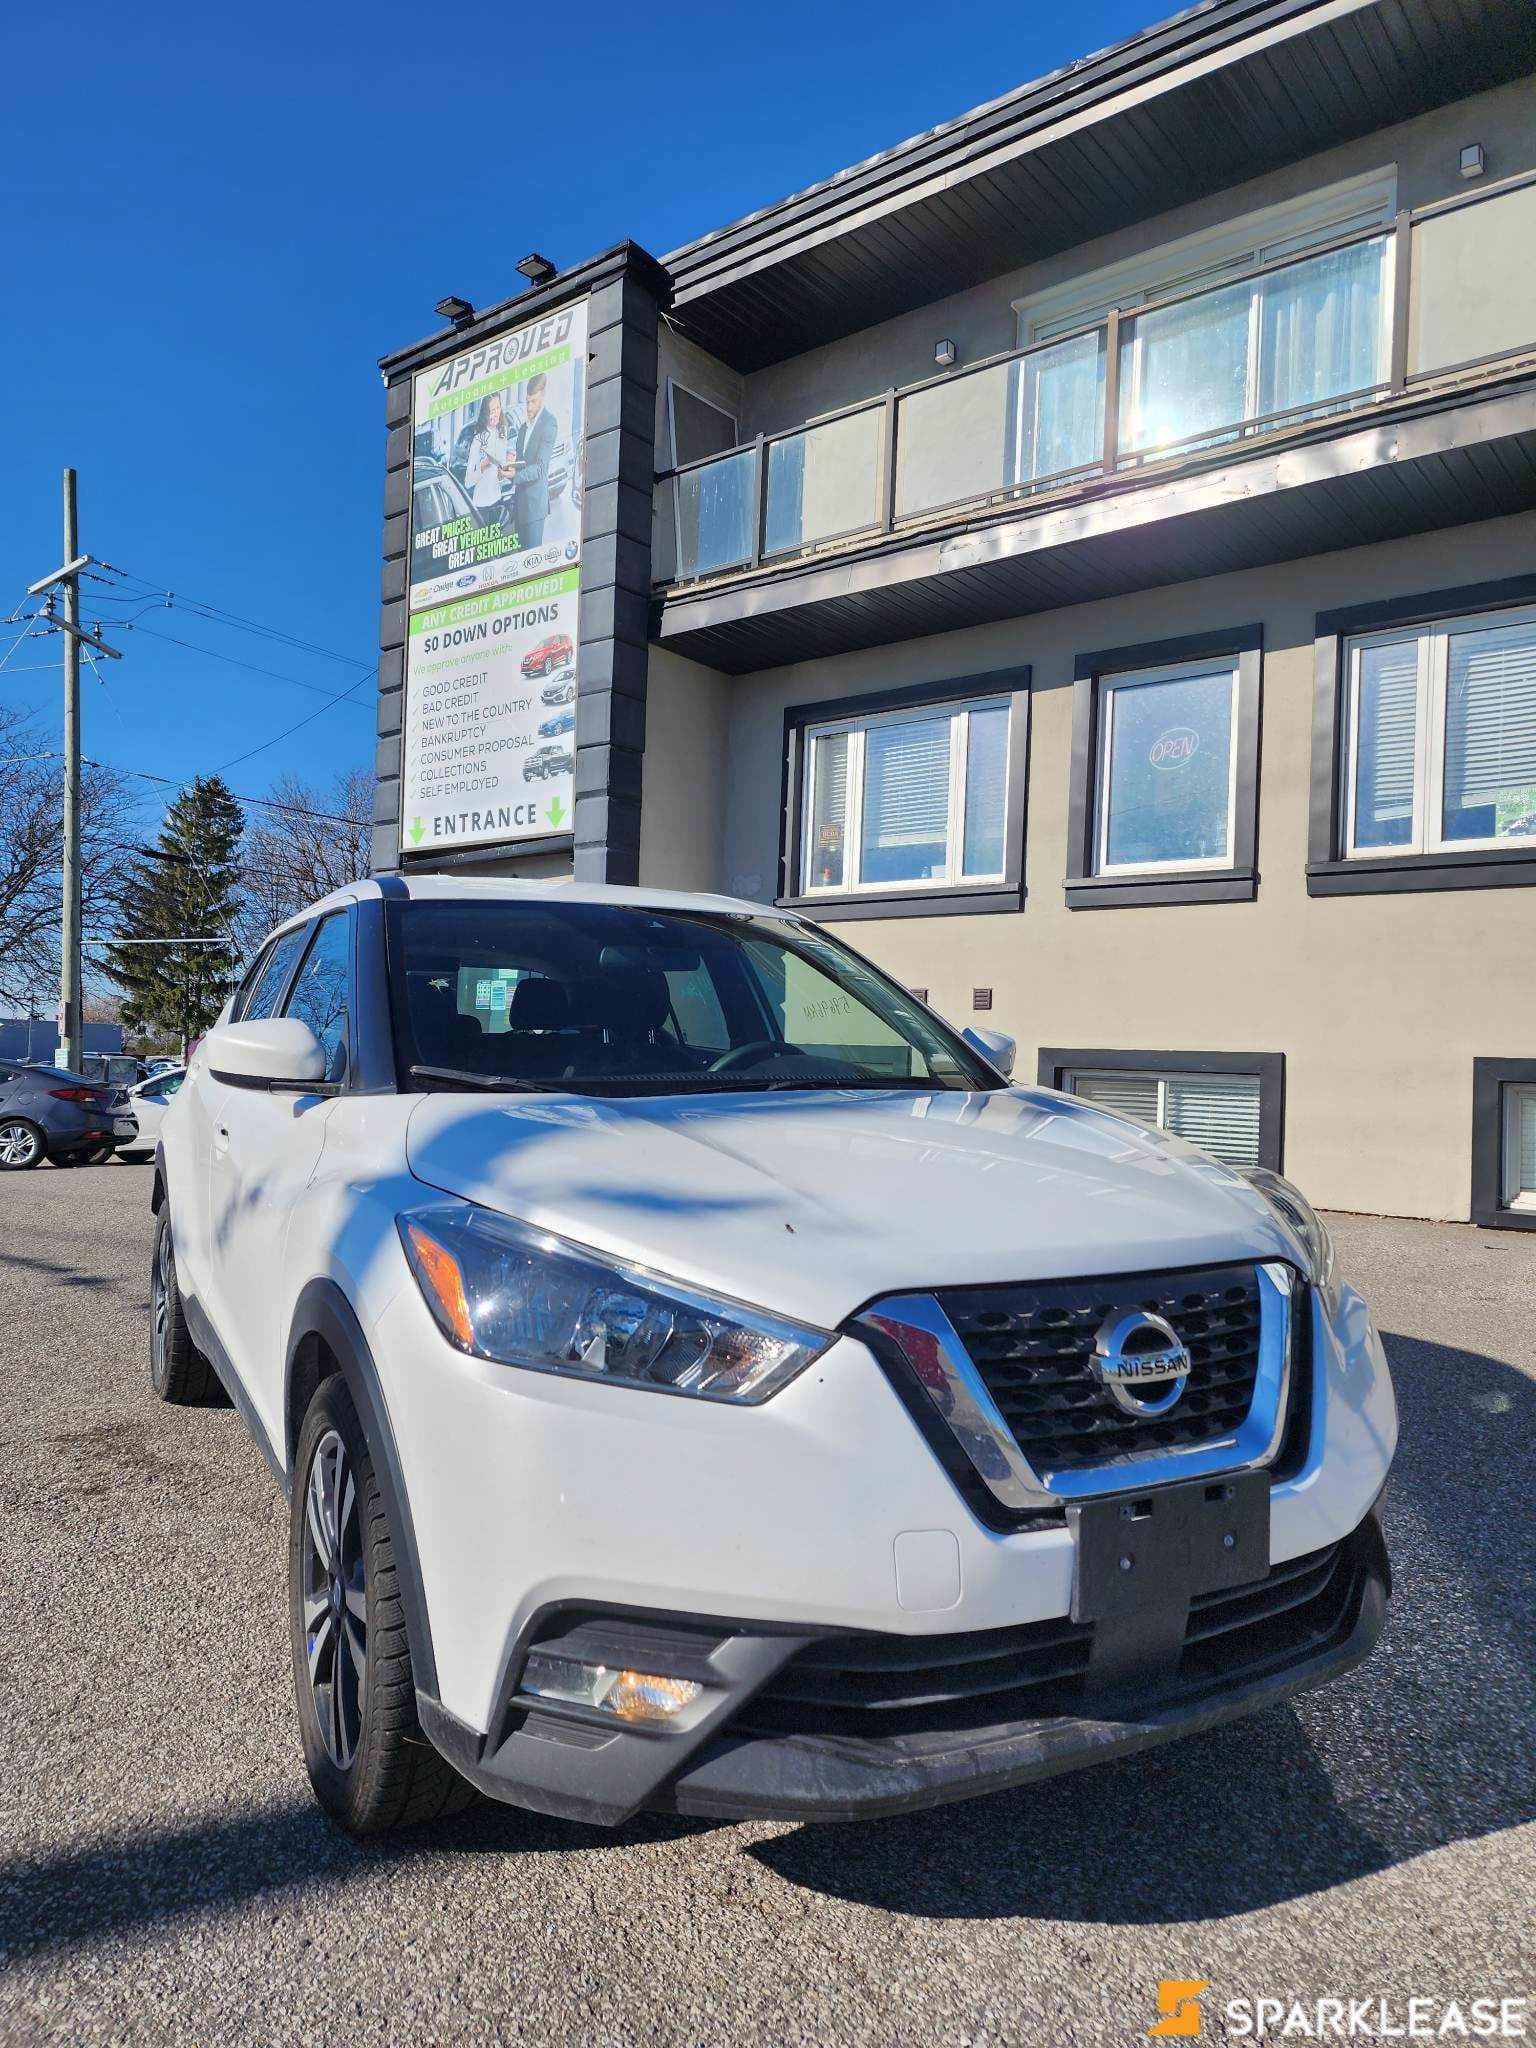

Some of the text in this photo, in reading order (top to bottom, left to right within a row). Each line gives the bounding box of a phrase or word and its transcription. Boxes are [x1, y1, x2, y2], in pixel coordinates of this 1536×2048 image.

[415, 526, 441, 549] GREAT
[432, 536, 459, 559] GREAT
[448, 546, 476, 570] GREAT
[476, 533, 521, 561] SERVICES.
[422, 577, 565, 629] ANY CREDIT APPROVED!
[424, 603, 559, 655] $0 DOWN OPTIONS
[422, 672, 488, 698] GOOD CREDIT
[422, 691, 480, 714] BAD CREDIT
[422, 697, 533, 731] NEW TO THE COUNTRY
[421, 724, 487, 748] BANKRUPTCY
[1152, 735, 1194, 762] OPEN
[421, 735, 535, 765] CONSUMER PROPOSAL
[420, 761, 487, 781] COLLECTIONS
[420, 776, 499, 799] SELF EMPLOYED
[433, 803, 537, 836] ENTRANCE
[1117, 1352, 1188, 1378] NISSAN
